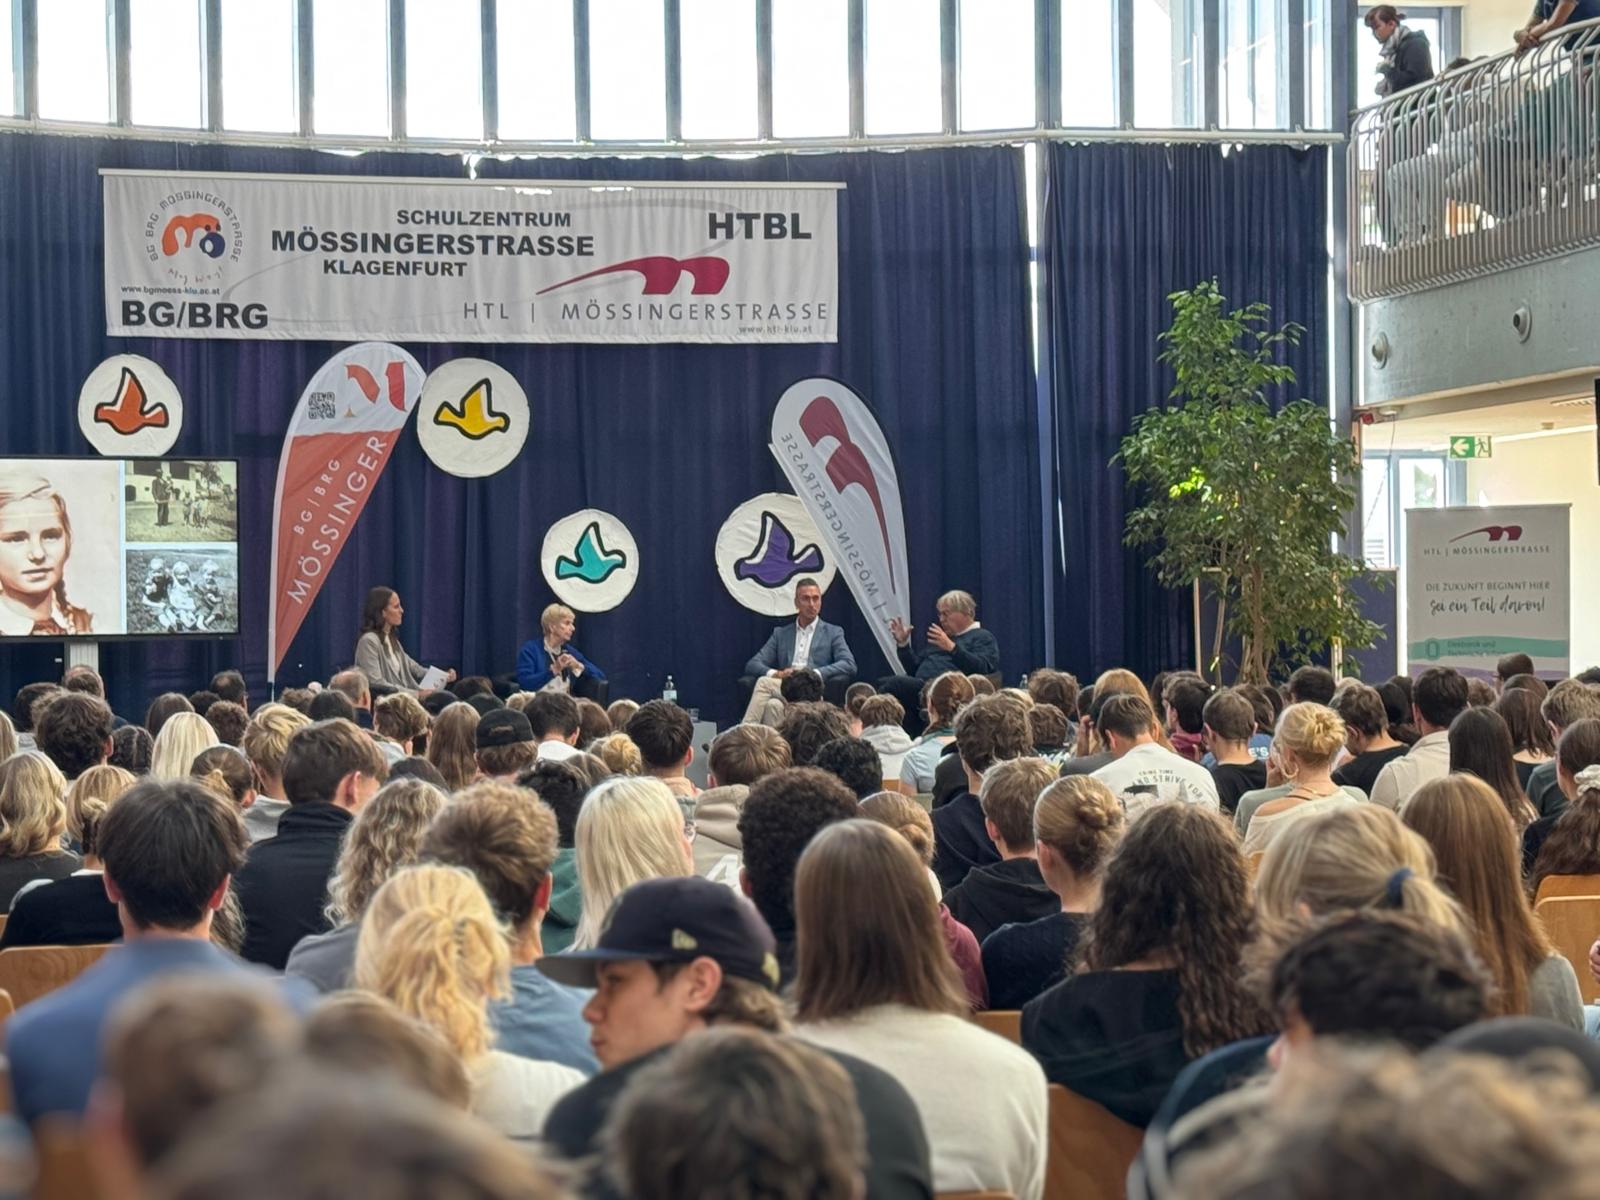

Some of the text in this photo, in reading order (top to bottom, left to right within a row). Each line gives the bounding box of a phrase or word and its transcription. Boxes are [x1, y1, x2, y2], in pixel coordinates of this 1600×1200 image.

[397, 209, 571, 228] SCHULZENTRUM
[708, 212, 812, 240] HTBL
[272, 225, 594, 257] MÖSSINGERSTRASSE
[323, 259, 468, 277] KLAGENFURT
[121, 300, 268, 330] BG/BRG
[463, 302, 509, 320] HTL
[561, 298, 828, 321] MÖSSINGERSTRASSE
[287, 435, 388, 604] MÖSSINGER
[1423, 547, 1441, 555] HTL
[1452, 545, 1550, 555] MÖSSINGERSTRASSE
[1425, 581, 1550, 592] DIE ZUKUNFT BEGINNT HIER
[1448, 600, 1468, 613] ein
[1471, 597, 1496, 614] Teil
[1499, 594, 1545, 614] davon!
